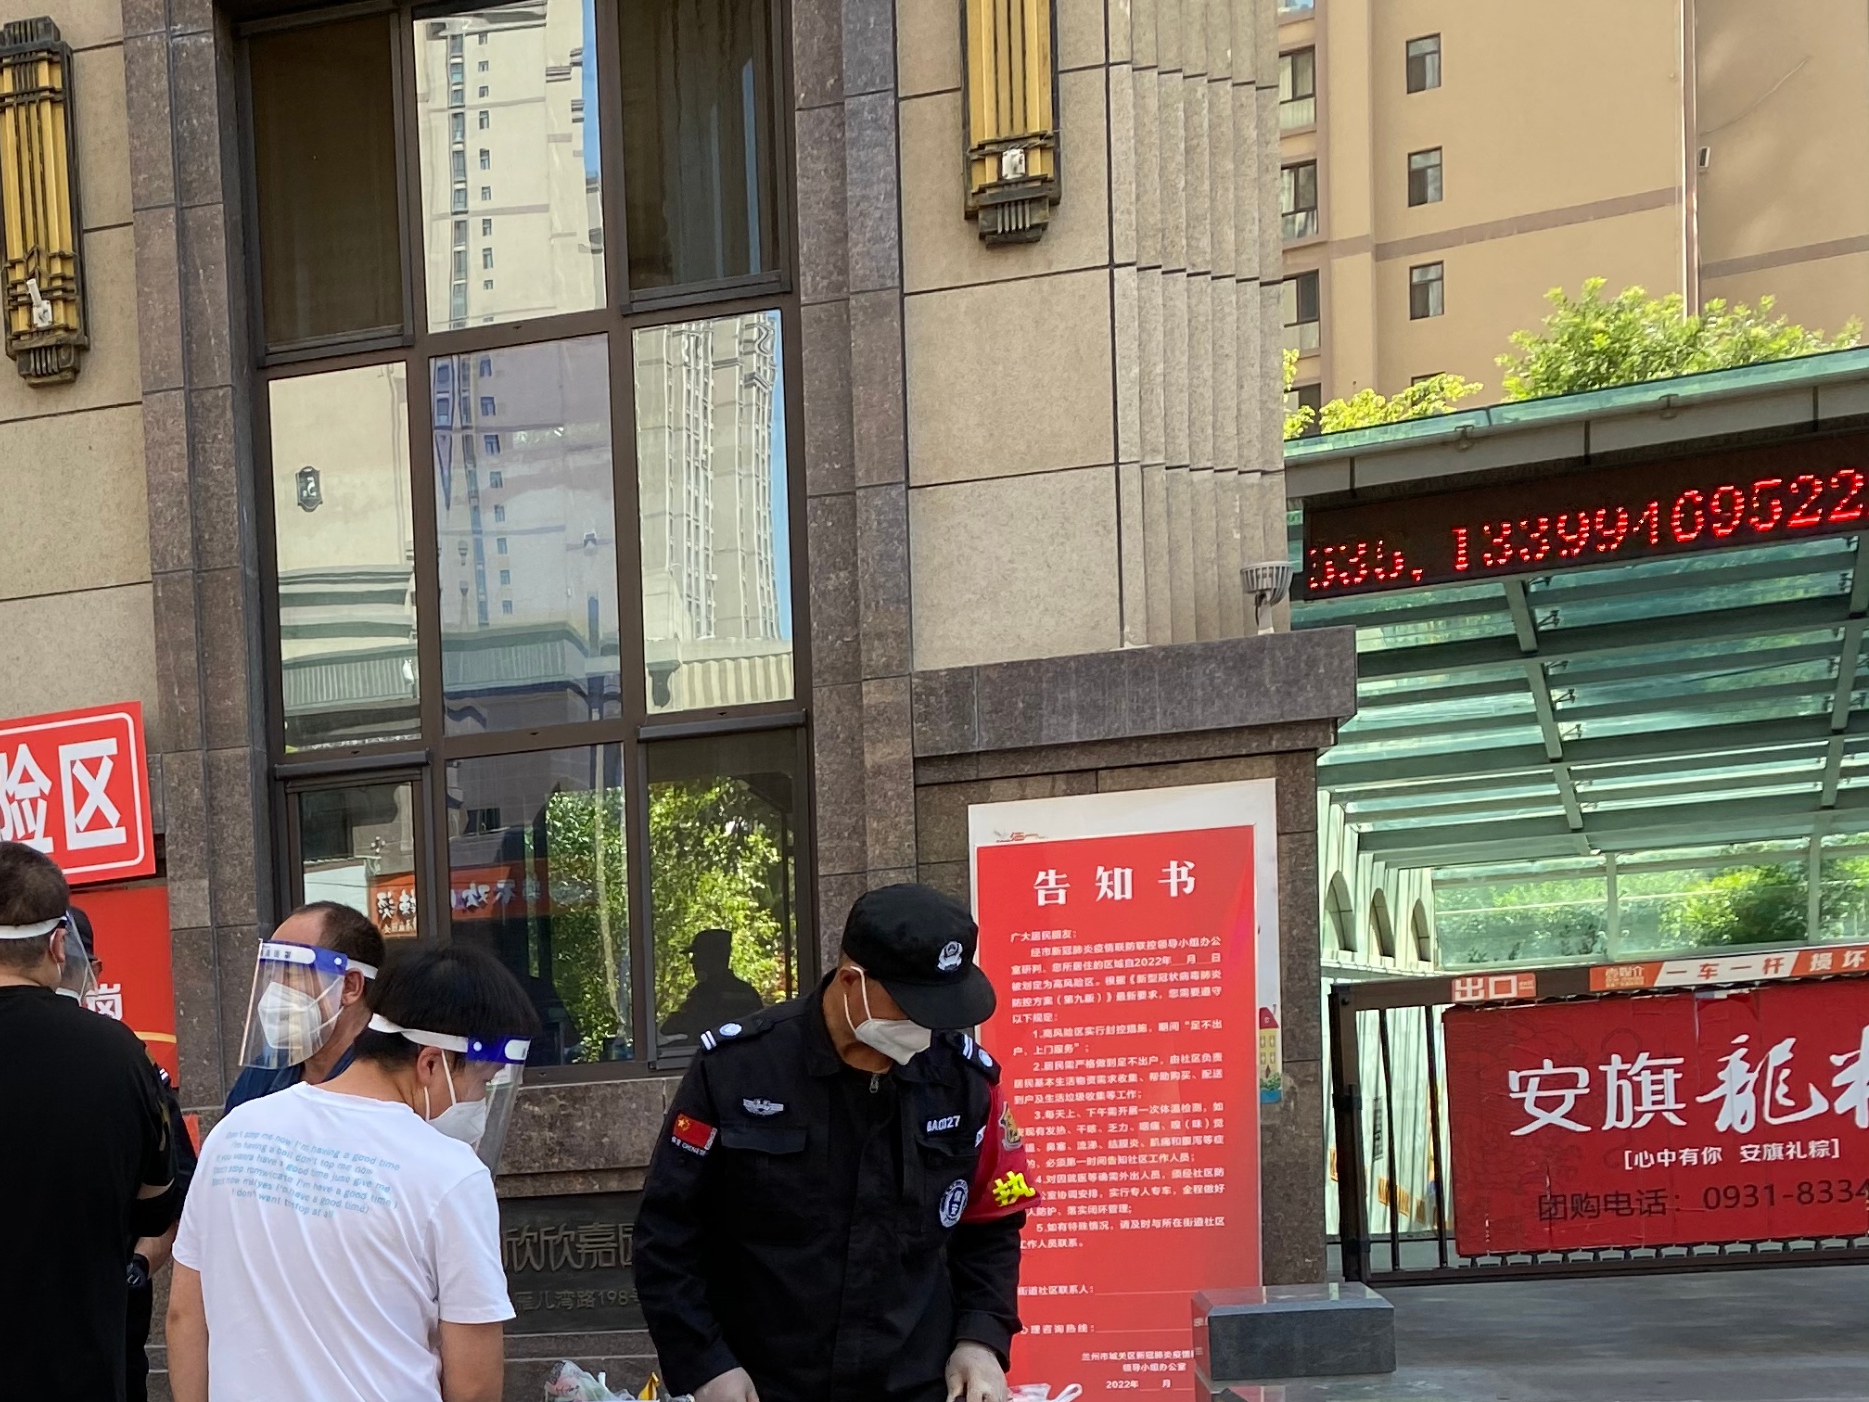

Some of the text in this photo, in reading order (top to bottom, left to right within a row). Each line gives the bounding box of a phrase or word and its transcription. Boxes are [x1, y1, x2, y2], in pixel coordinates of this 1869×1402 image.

[1033, 860, 1196, 907] 告知书
[1666, 955, 1785, 980] 一车一杆
[1809, 950, 1868, 972] 损坏
[1454, 975, 1517, 1001] 出口
